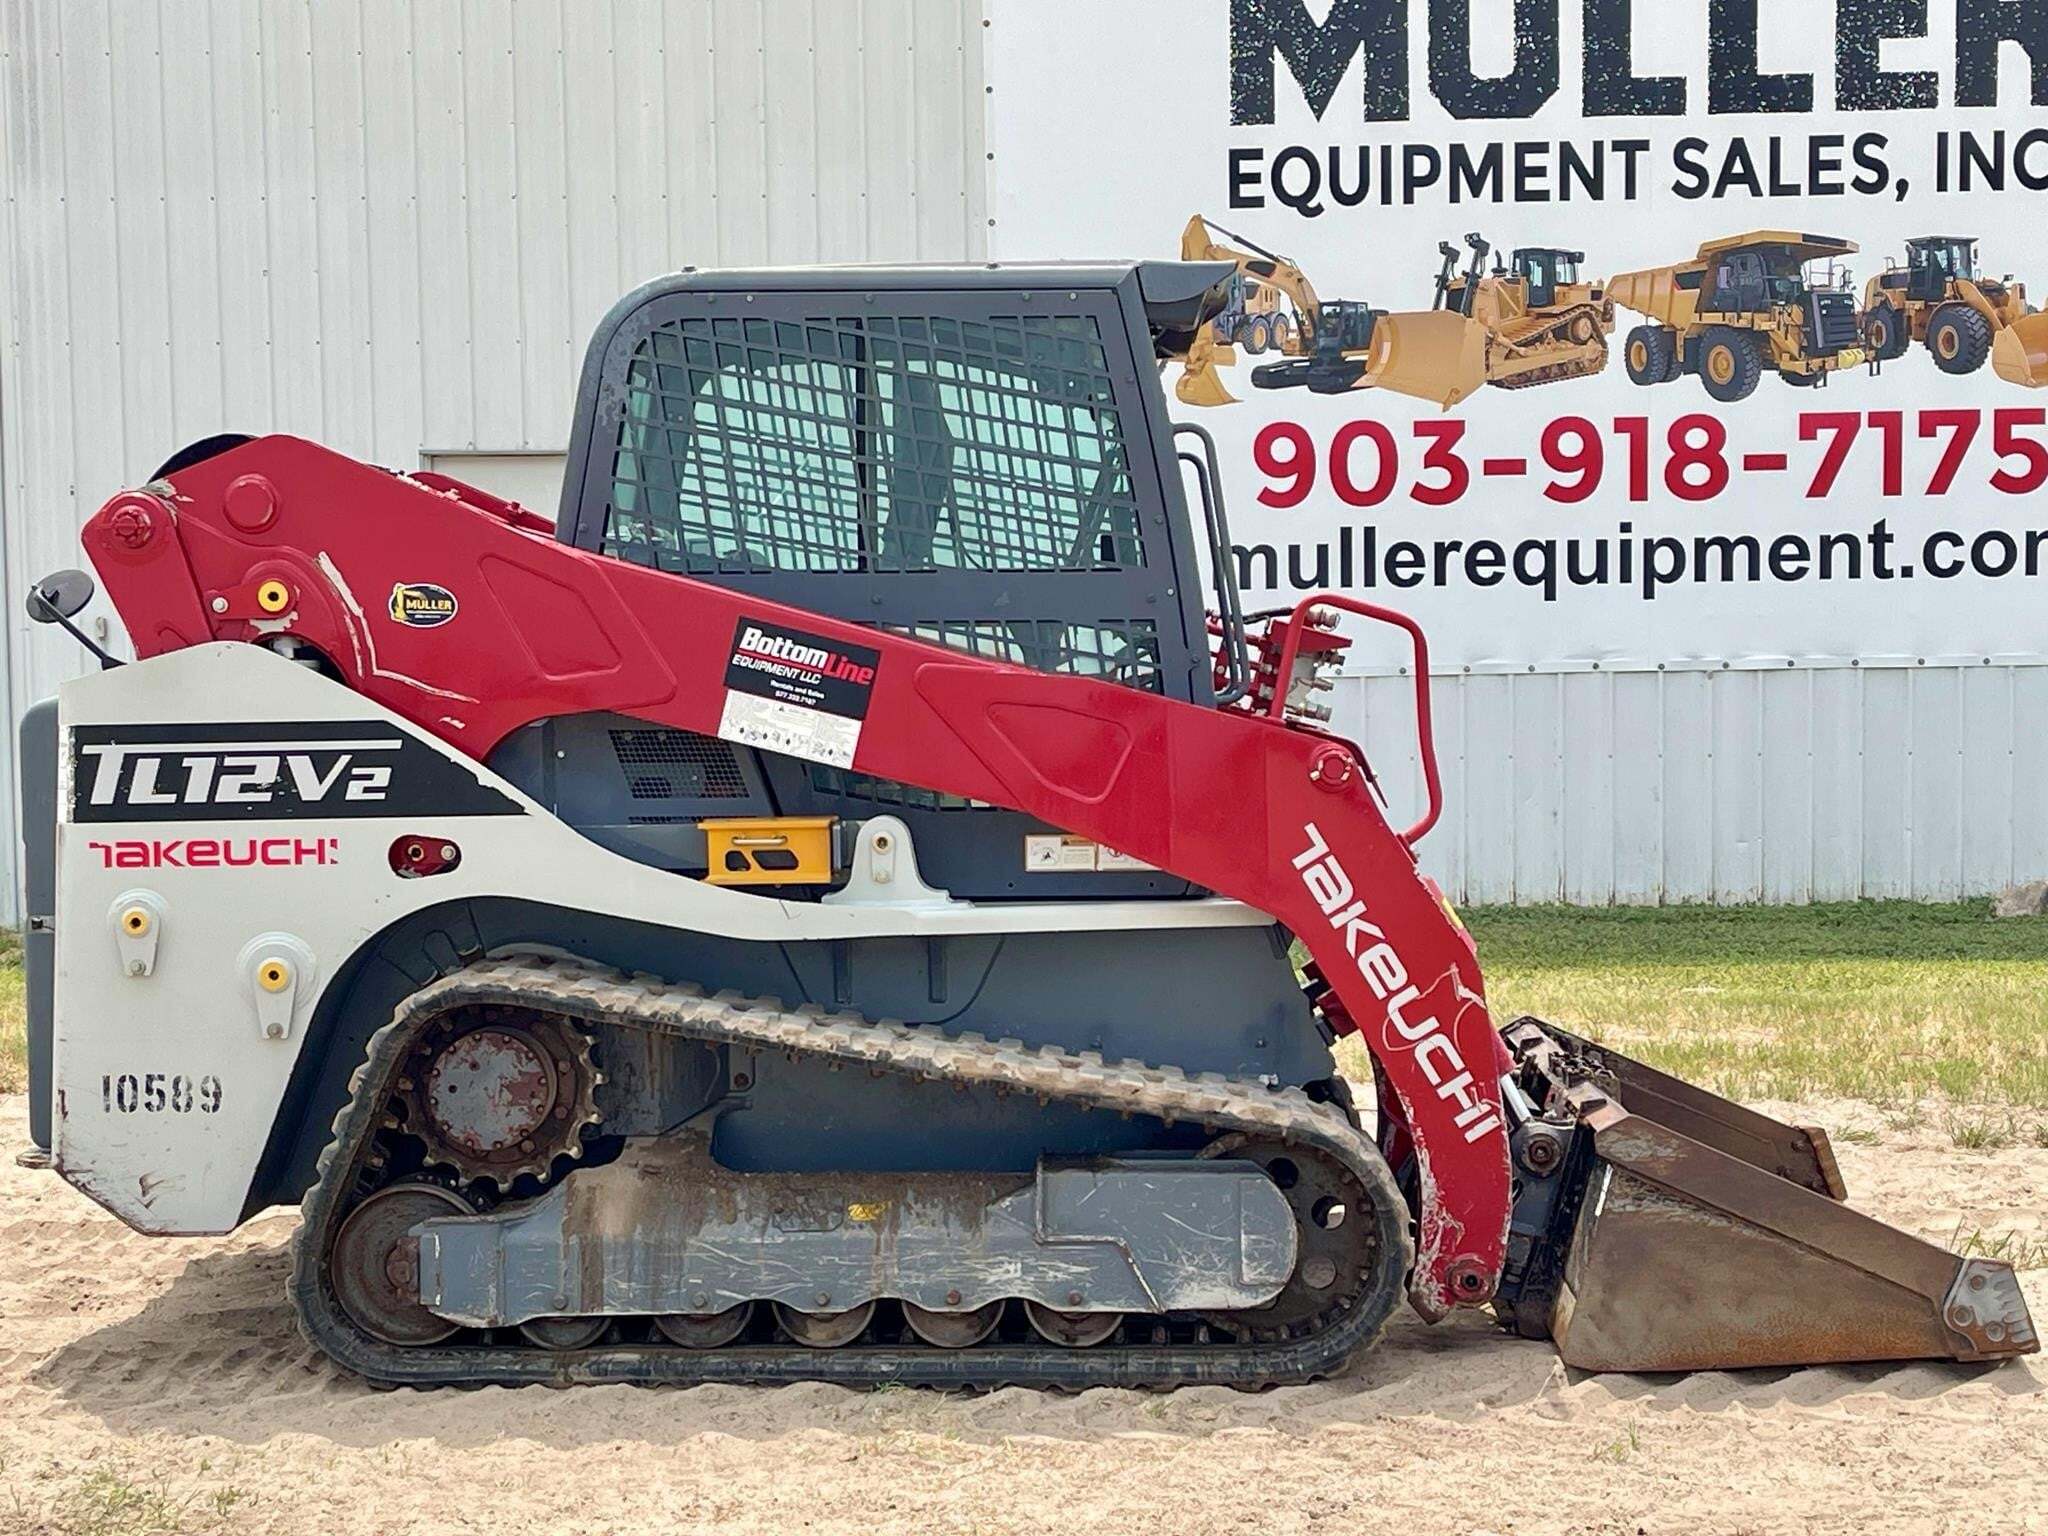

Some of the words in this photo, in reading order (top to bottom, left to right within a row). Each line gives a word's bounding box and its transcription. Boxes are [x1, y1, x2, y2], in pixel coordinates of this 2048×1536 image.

[1230, 0, 2048, 125] MULLER
[1228, 139, 1650, 218] EQUIPMENT
[1672, 132, 1909, 202] SALES,
[1253, 408, 2048, 509] 903-918-7175
[406, 599, 452, 610] MULLER
[732, 654, 801, 680] EQUIPMENT
[799, 670, 822, 685] LLC
[1292, 822, 1500, 1144] TAKEUCHI
[102, 1074, 222, 1113] 10589
